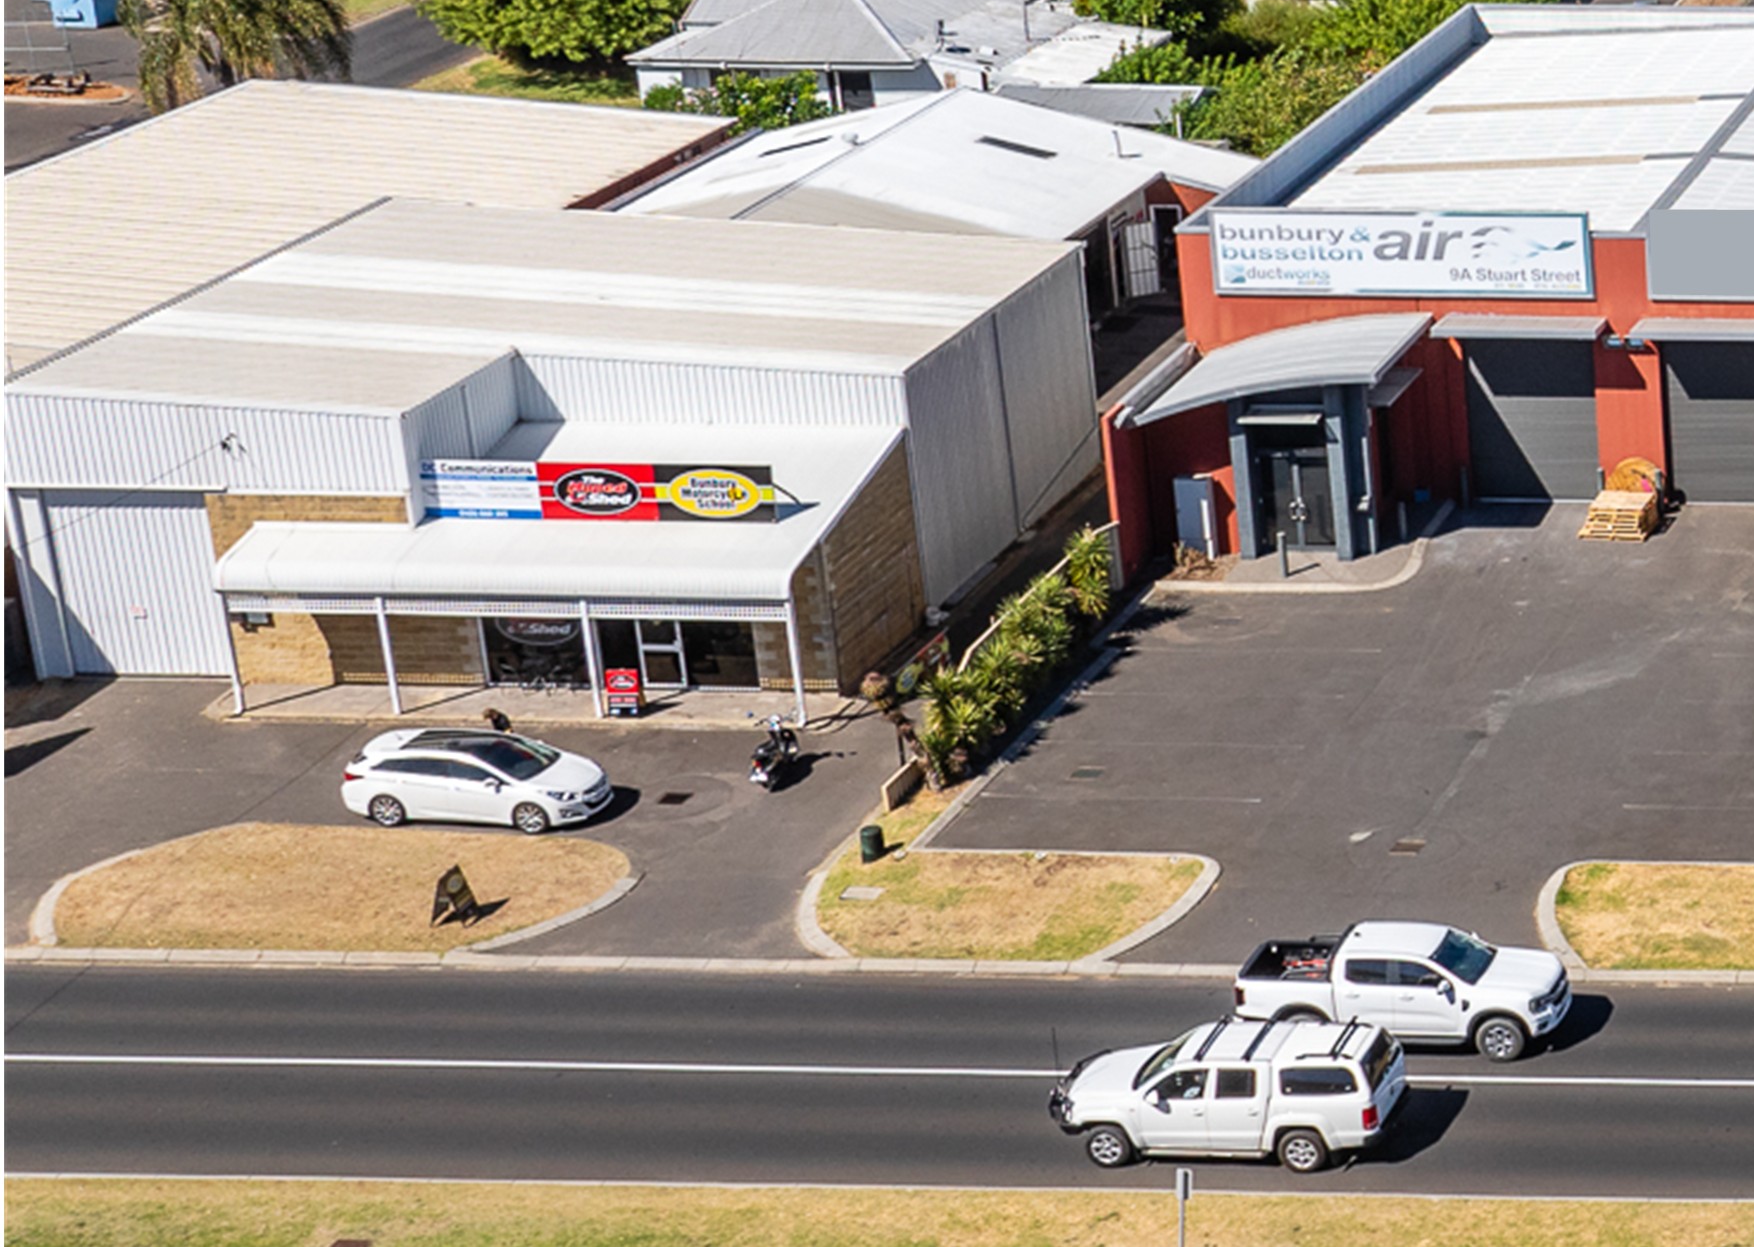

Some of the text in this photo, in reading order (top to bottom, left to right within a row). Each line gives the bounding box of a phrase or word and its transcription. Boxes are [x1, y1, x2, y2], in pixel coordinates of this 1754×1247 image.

[1219, 220, 1463, 262] bunbury & air
[1221, 244, 1364, 261] busselton
[1246, 266, 1331, 280] ductworks
[1449, 268, 1581, 283] 9A Stuart Street
[440, 463, 534, 474] Communications
[691, 478, 736, 488] Bunbury
[698, 499, 736, 509] School
